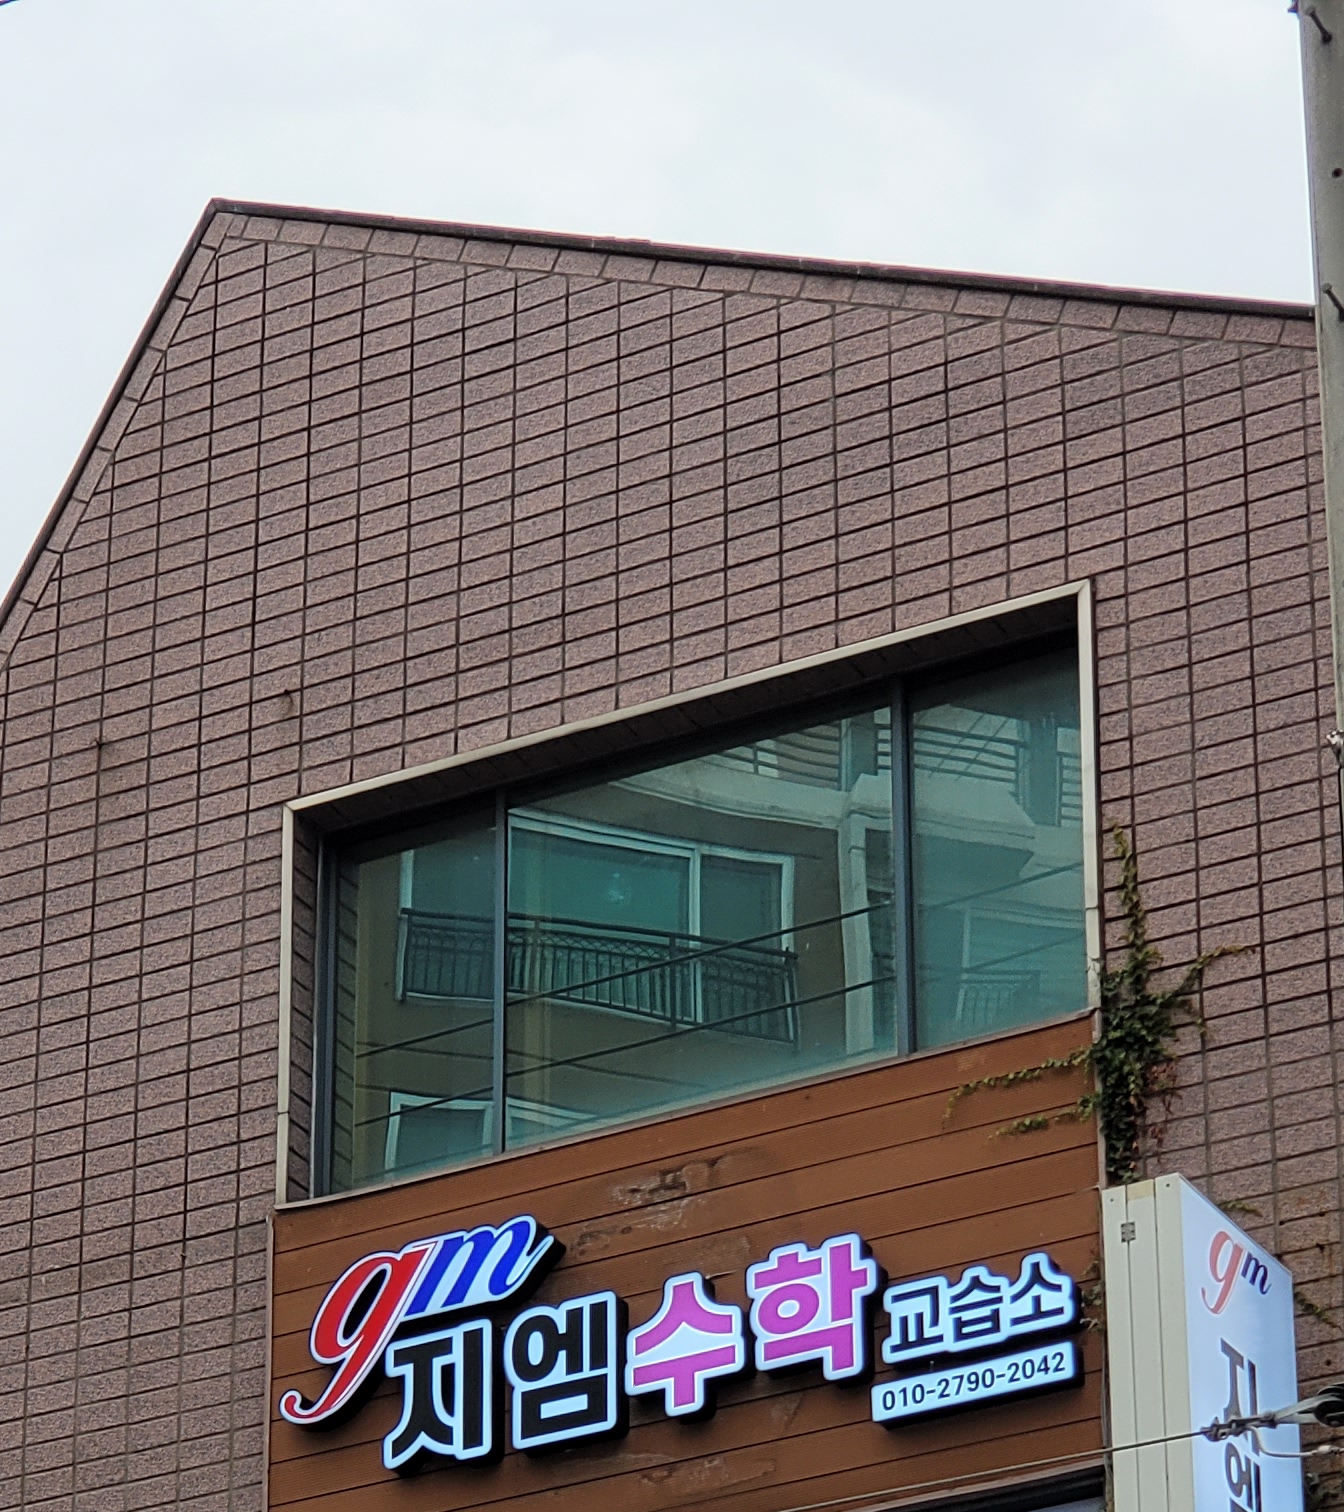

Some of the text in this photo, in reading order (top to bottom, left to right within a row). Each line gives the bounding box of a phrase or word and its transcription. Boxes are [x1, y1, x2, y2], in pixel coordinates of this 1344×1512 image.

[887, 1260, 1066, 1355] 교습소
[1200, 1230, 1273, 1315] gm
[280, 1214, 554, 1424] gm
[881, 1350, 1067, 1412] 010-2790-2042
